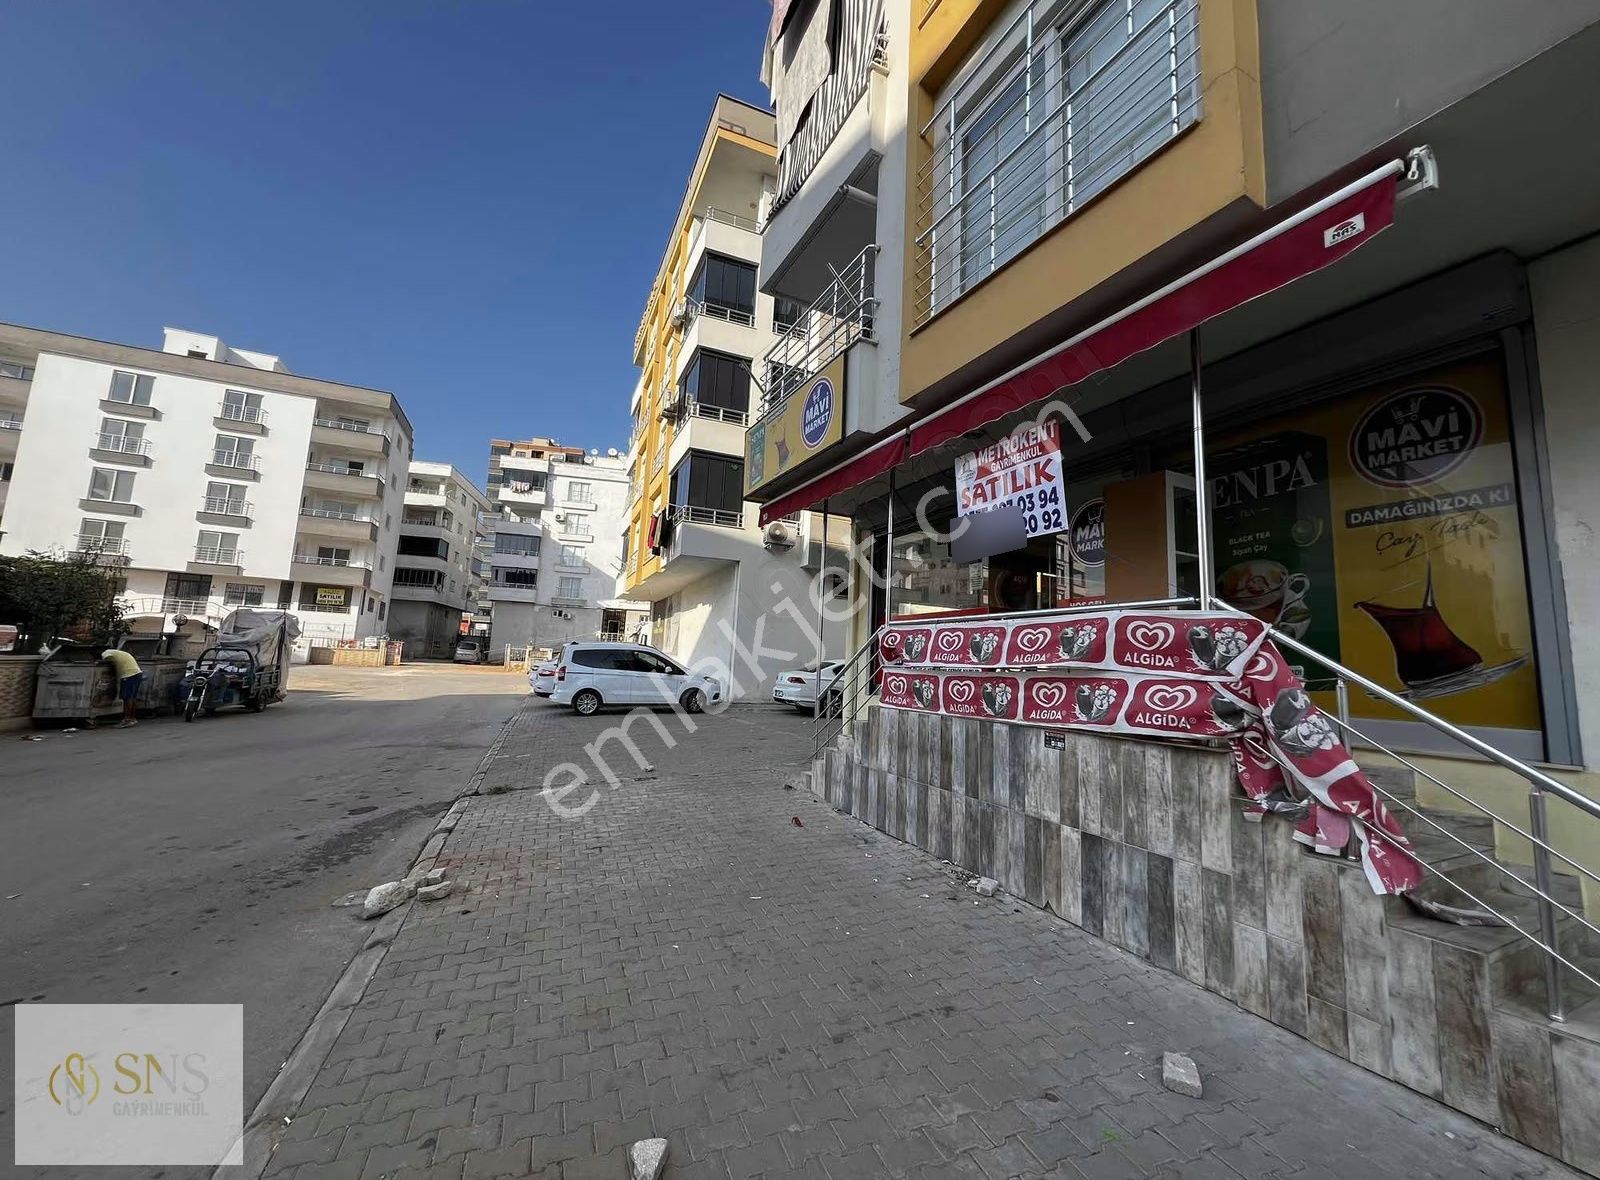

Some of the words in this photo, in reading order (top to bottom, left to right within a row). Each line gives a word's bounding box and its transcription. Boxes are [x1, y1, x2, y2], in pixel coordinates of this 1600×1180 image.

[804, 412, 830, 434] MARKET
[805, 391, 829, 423] MAVİ
[977, 419, 1057, 466] METROKENT
[1367, 405, 1460, 453] MAVİ
[1367, 435, 1464, 469] MARKET
[961, 457, 1056, 509] SATILIK
[1038, 486, 1059, 508] 94
[1041, 508, 1063, 530] 92
